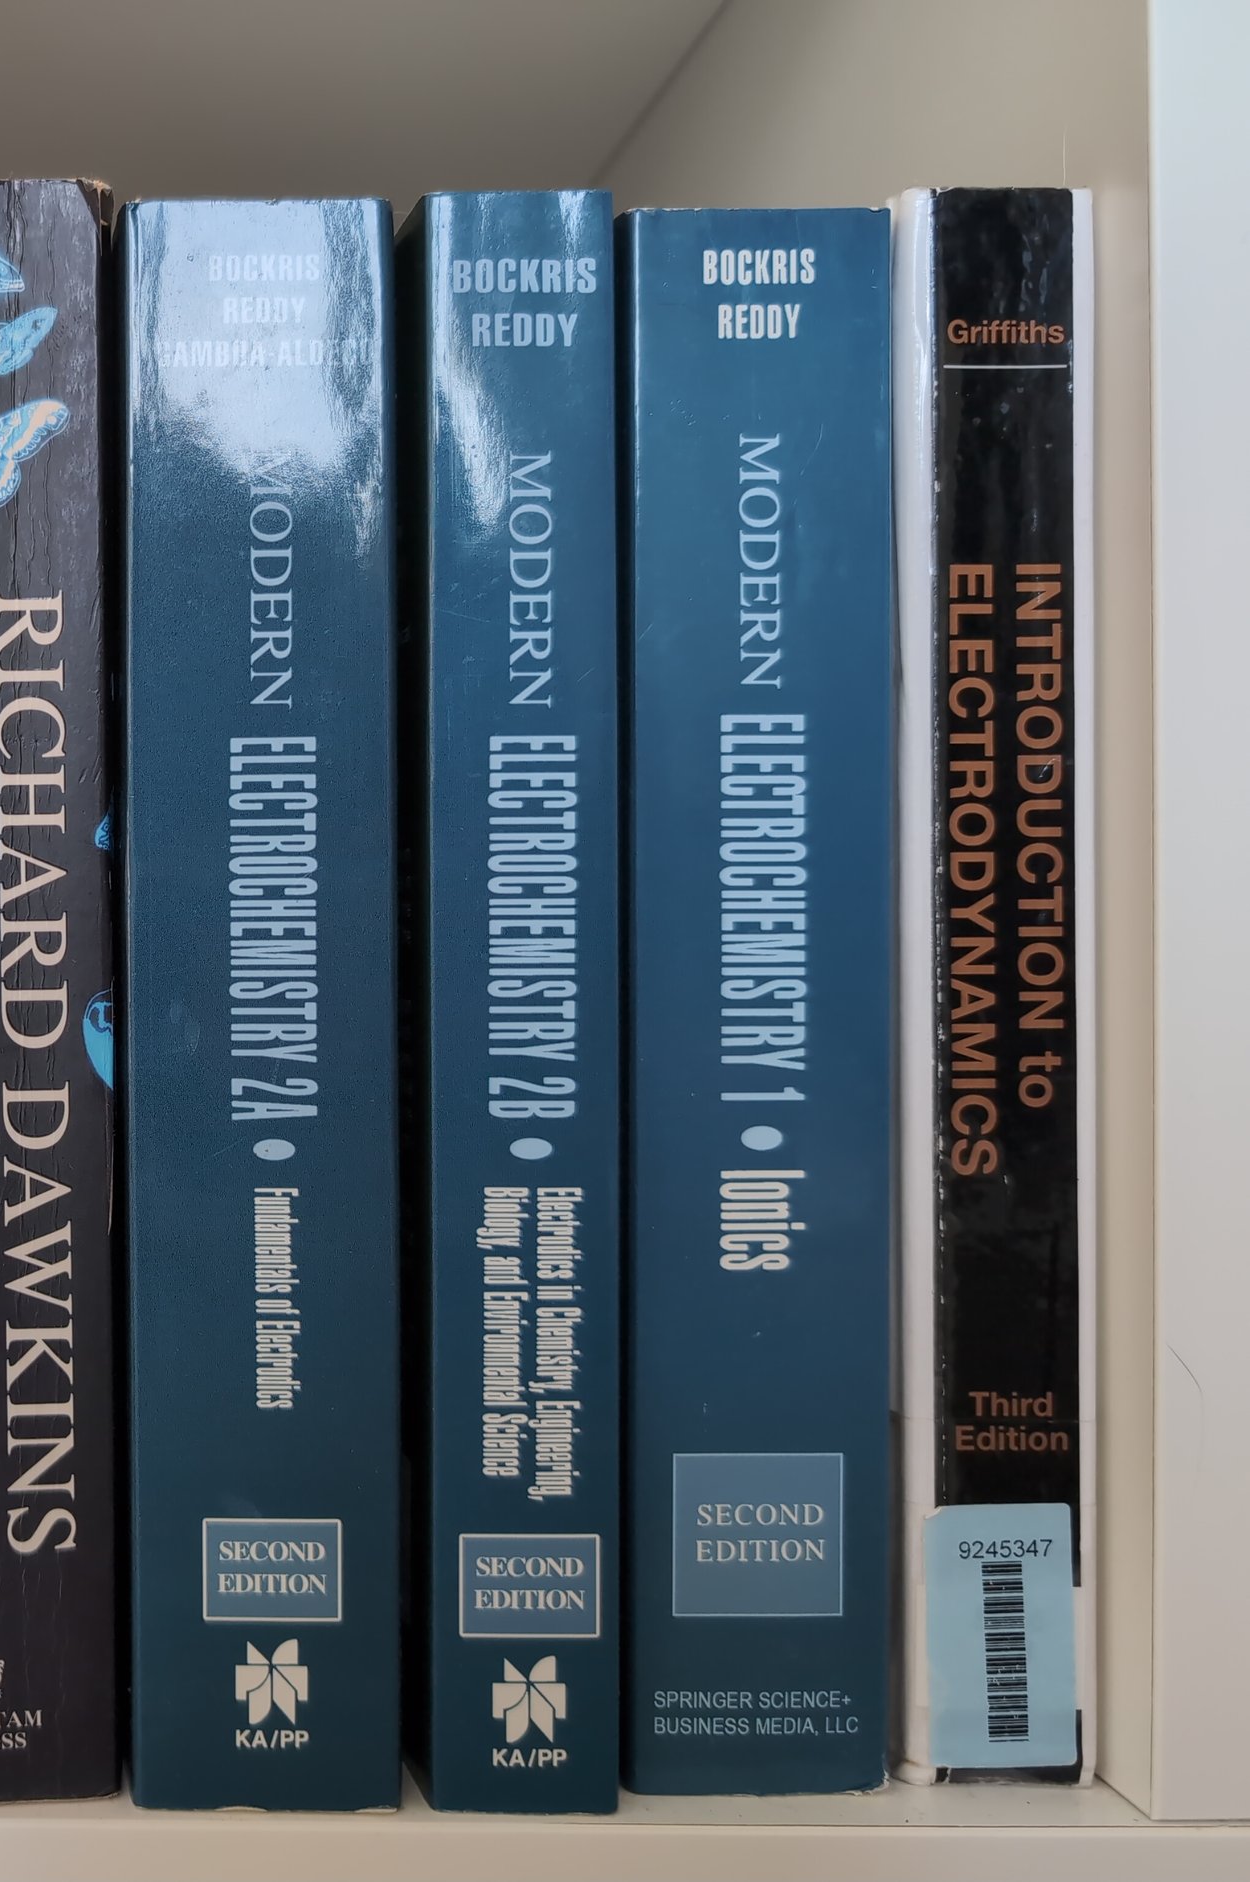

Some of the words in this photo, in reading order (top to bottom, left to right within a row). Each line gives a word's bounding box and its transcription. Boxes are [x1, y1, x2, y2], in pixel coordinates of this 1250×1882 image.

[209, 254, 320, 282] BOCKRIS
[451, 258, 597, 294] BOCKRIS
[703, 248, 816, 286] BOCKRIS
[223, 297, 306, 324] REDDY
[717, 303, 802, 340] REDDY
[471, 312, 578, 348] REDDY
[947, 319, 1065, 346] Griffiths
[250, 450, 293, 710] MODERN
[738, 433, 782, 690] MODERN
[508, 451, 552, 710] MODERN
[1015, 563, 1065, 1030] INTRODUCTION
[948, 563, 999, 1177] ELECTRODYNAMICS
[229, 736, 318, 1063] ELECTROCHEMISTRY
[487, 734, 578, 1062] ELECTROCHEMISTRY
[719, 713, 806, 1071] ELECTROCHEMISTRY
[488, 1076, 577, 1119] 2B
[720, 1086, 805, 1102] 1
[1017, 1050, 1063, 1109] to
[230, 1077, 318, 1121] 2A
[476, 1186, 529, 1249] Biology,
[537, 1187, 583, 1279] Electrodics
[719, 1169, 806, 1271] Ionics
[254, 1186, 299, 1293] Fundamentals
[483, 1256, 529, 1285] and
[255, 1298, 299, 1315] of
[536, 1285, 582, 1300] in
[2, 1081, 78, 1556] DAWKINS
[255, 1319, 301, 1410] Electrodics
[483, 1291, 529, 1406] Environmental
[528, 1306, 581, 1394] Chemistry,
[968, 1391, 1052, 1419] Third
[482, 1412, 529, 1477] Science
[527, 1400, 581, 1500] Engineering,
[954, 1425, 1069, 1453] Edition
[696, 1503, 824, 1527] SECOND
[218, 1540, 326, 1563] SECOND
[476, 1555, 583, 1578] SECOND
[696, 1538, 825, 1563] EDITION
[958, 1539, 1052, 1560] 9245347
[217, 1573, 327, 1595] EDITION
[474, 1588, 585, 1612] EDITION
[653, 1690, 753, 1710] SPRINGER
[757, 1690, 852, 1710] SCIENCE+
[235, 1729, 309, 1749] KA/PP
[653, 1716, 750, 1735] BUSINESS
[755, 1716, 819, 1737] MEDIA,
[824, 1715, 859, 1734] LLC
[492, 1747, 567, 1768] KA/PP
